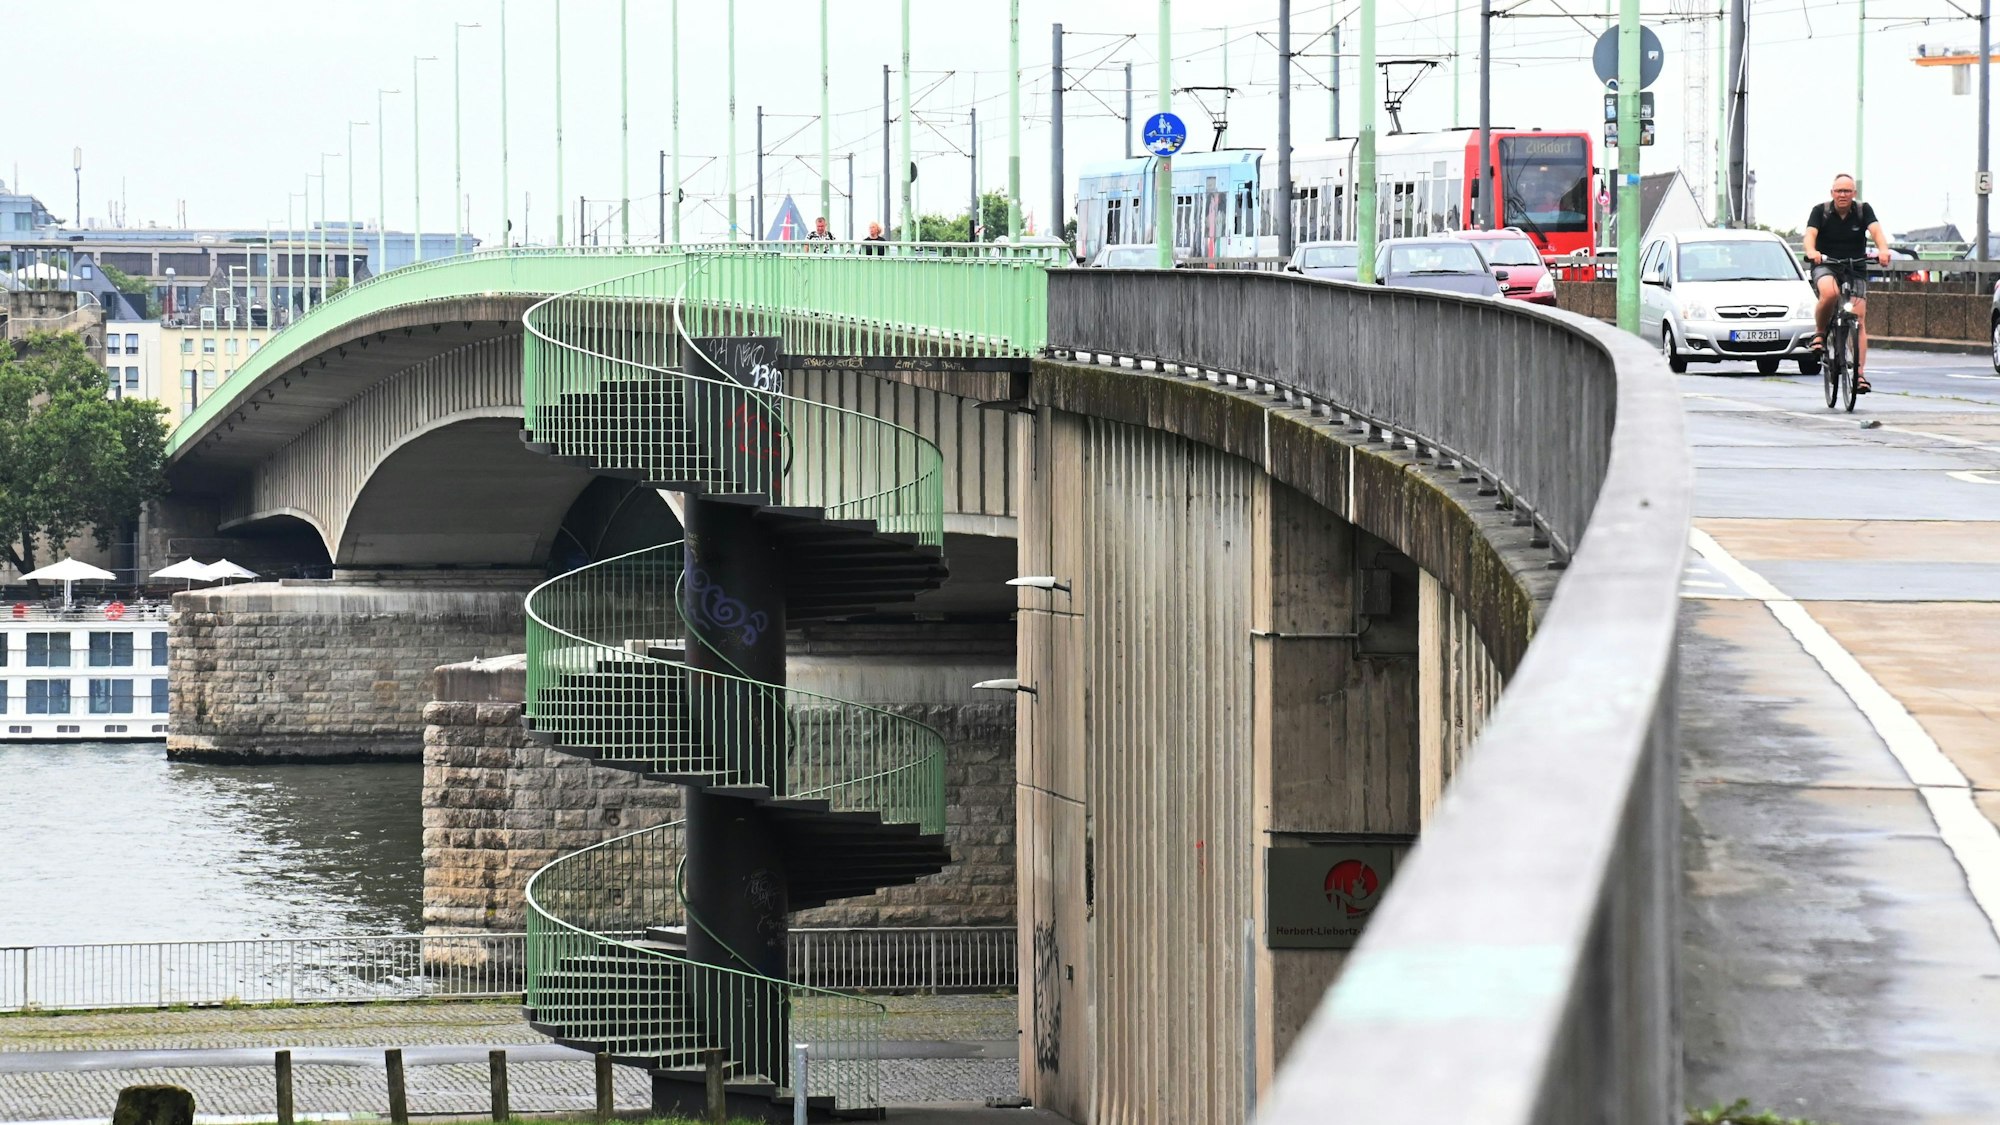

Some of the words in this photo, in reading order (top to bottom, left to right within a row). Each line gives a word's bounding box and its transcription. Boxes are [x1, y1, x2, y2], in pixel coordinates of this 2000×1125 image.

[1980, 174, 1988, 191] 5
[1735, 331, 1741, 340] K
[1747, 331, 1757, 340] IR
[1758, 331, 1778, 340] 2811
